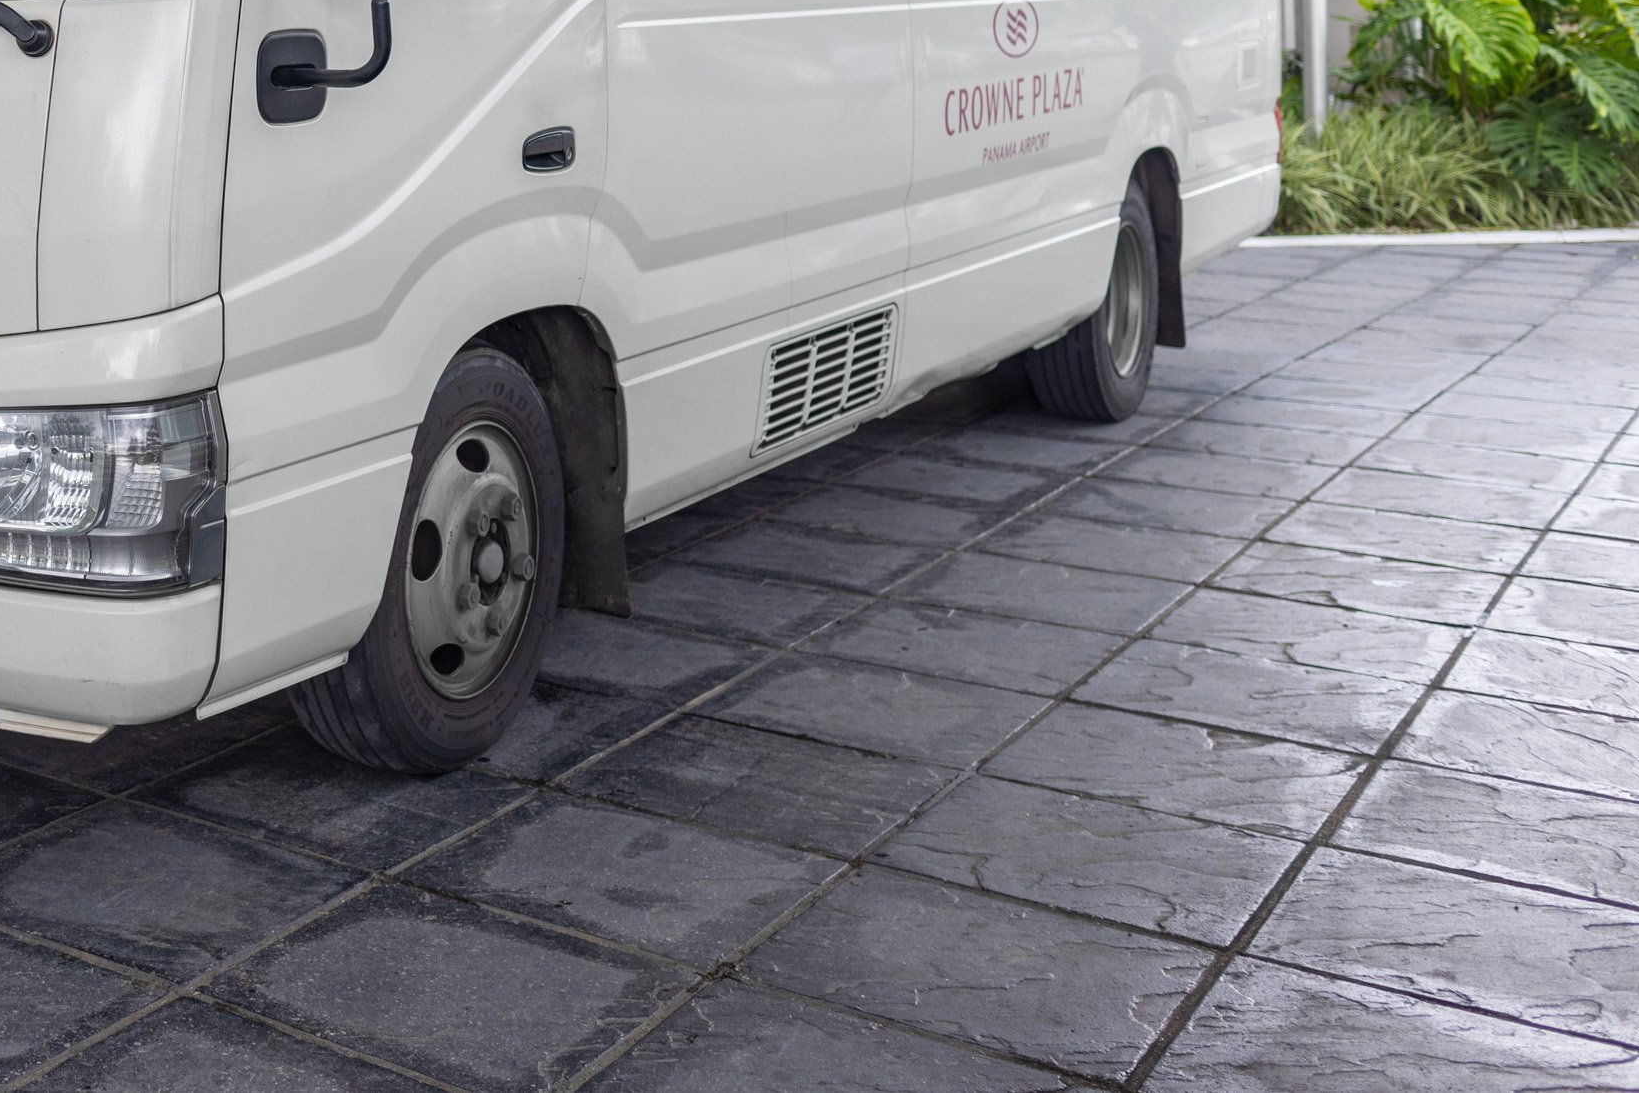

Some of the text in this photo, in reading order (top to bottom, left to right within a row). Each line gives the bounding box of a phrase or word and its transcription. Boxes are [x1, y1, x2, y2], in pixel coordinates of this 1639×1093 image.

[944, 77, 1024, 137] CROWNE
[982, 131, 1050, 164] PANAMA AIRPORT
